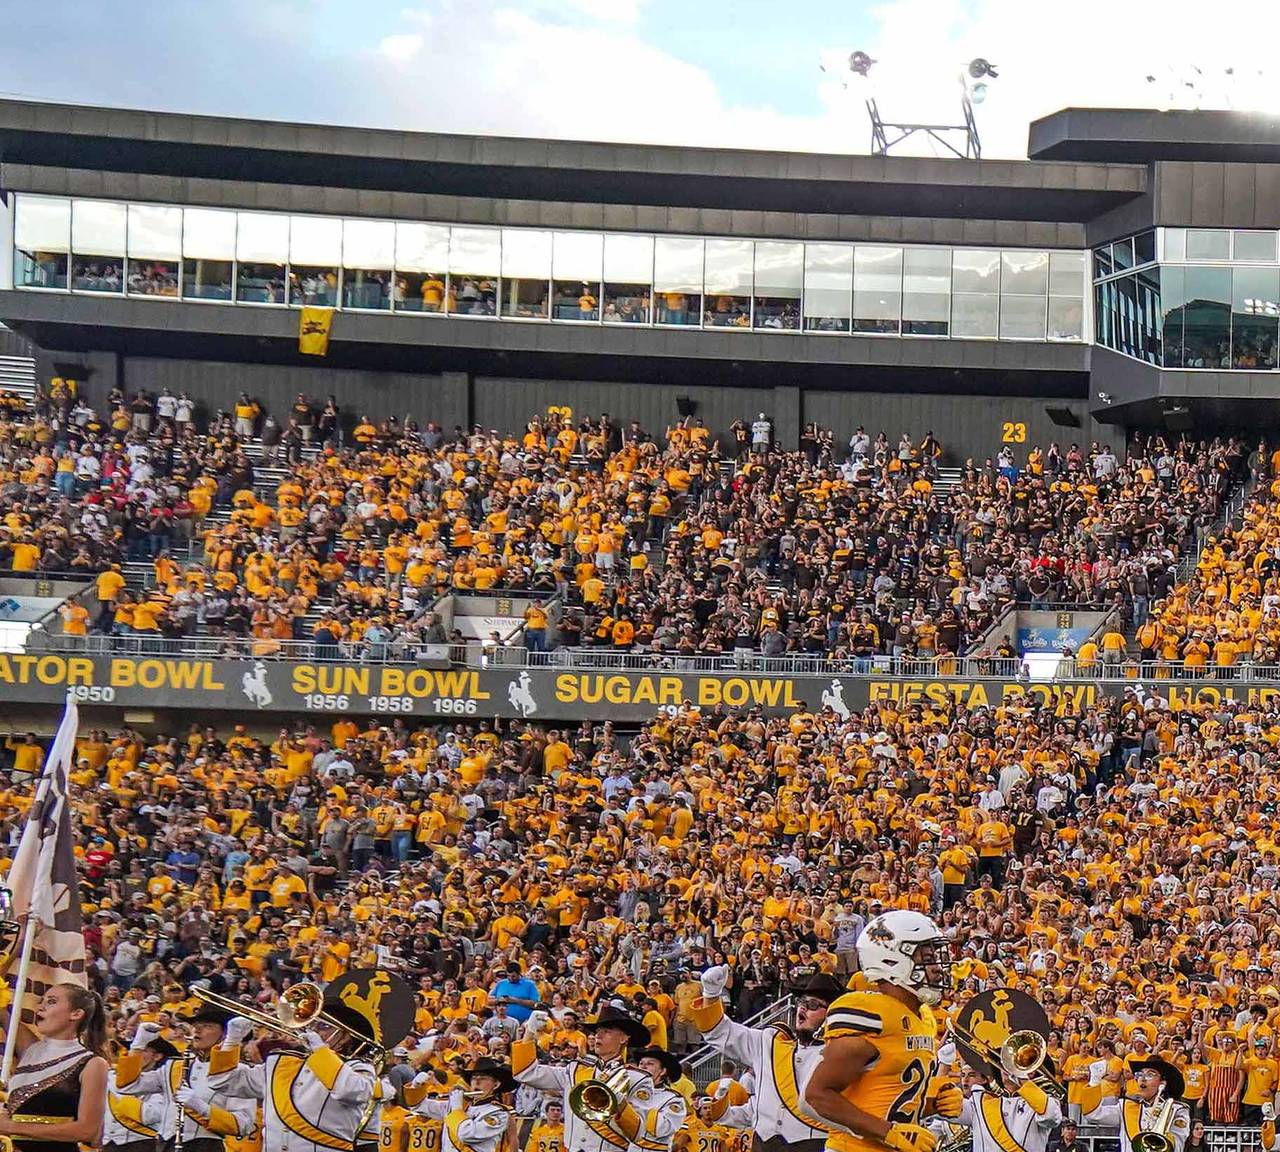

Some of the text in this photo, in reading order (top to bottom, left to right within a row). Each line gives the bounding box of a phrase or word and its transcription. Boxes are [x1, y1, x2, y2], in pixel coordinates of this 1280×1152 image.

[1003, 422, 1026, 443] 23
[0, 655, 225, 691] ATOR BOWL
[292, 665, 490, 699] SUN BOWL
[304, 694, 477, 714] 1956 1958 1966
[555, 674, 800, 707] SUGAR BOWL
[413, 1128, 436, 1149] 30
